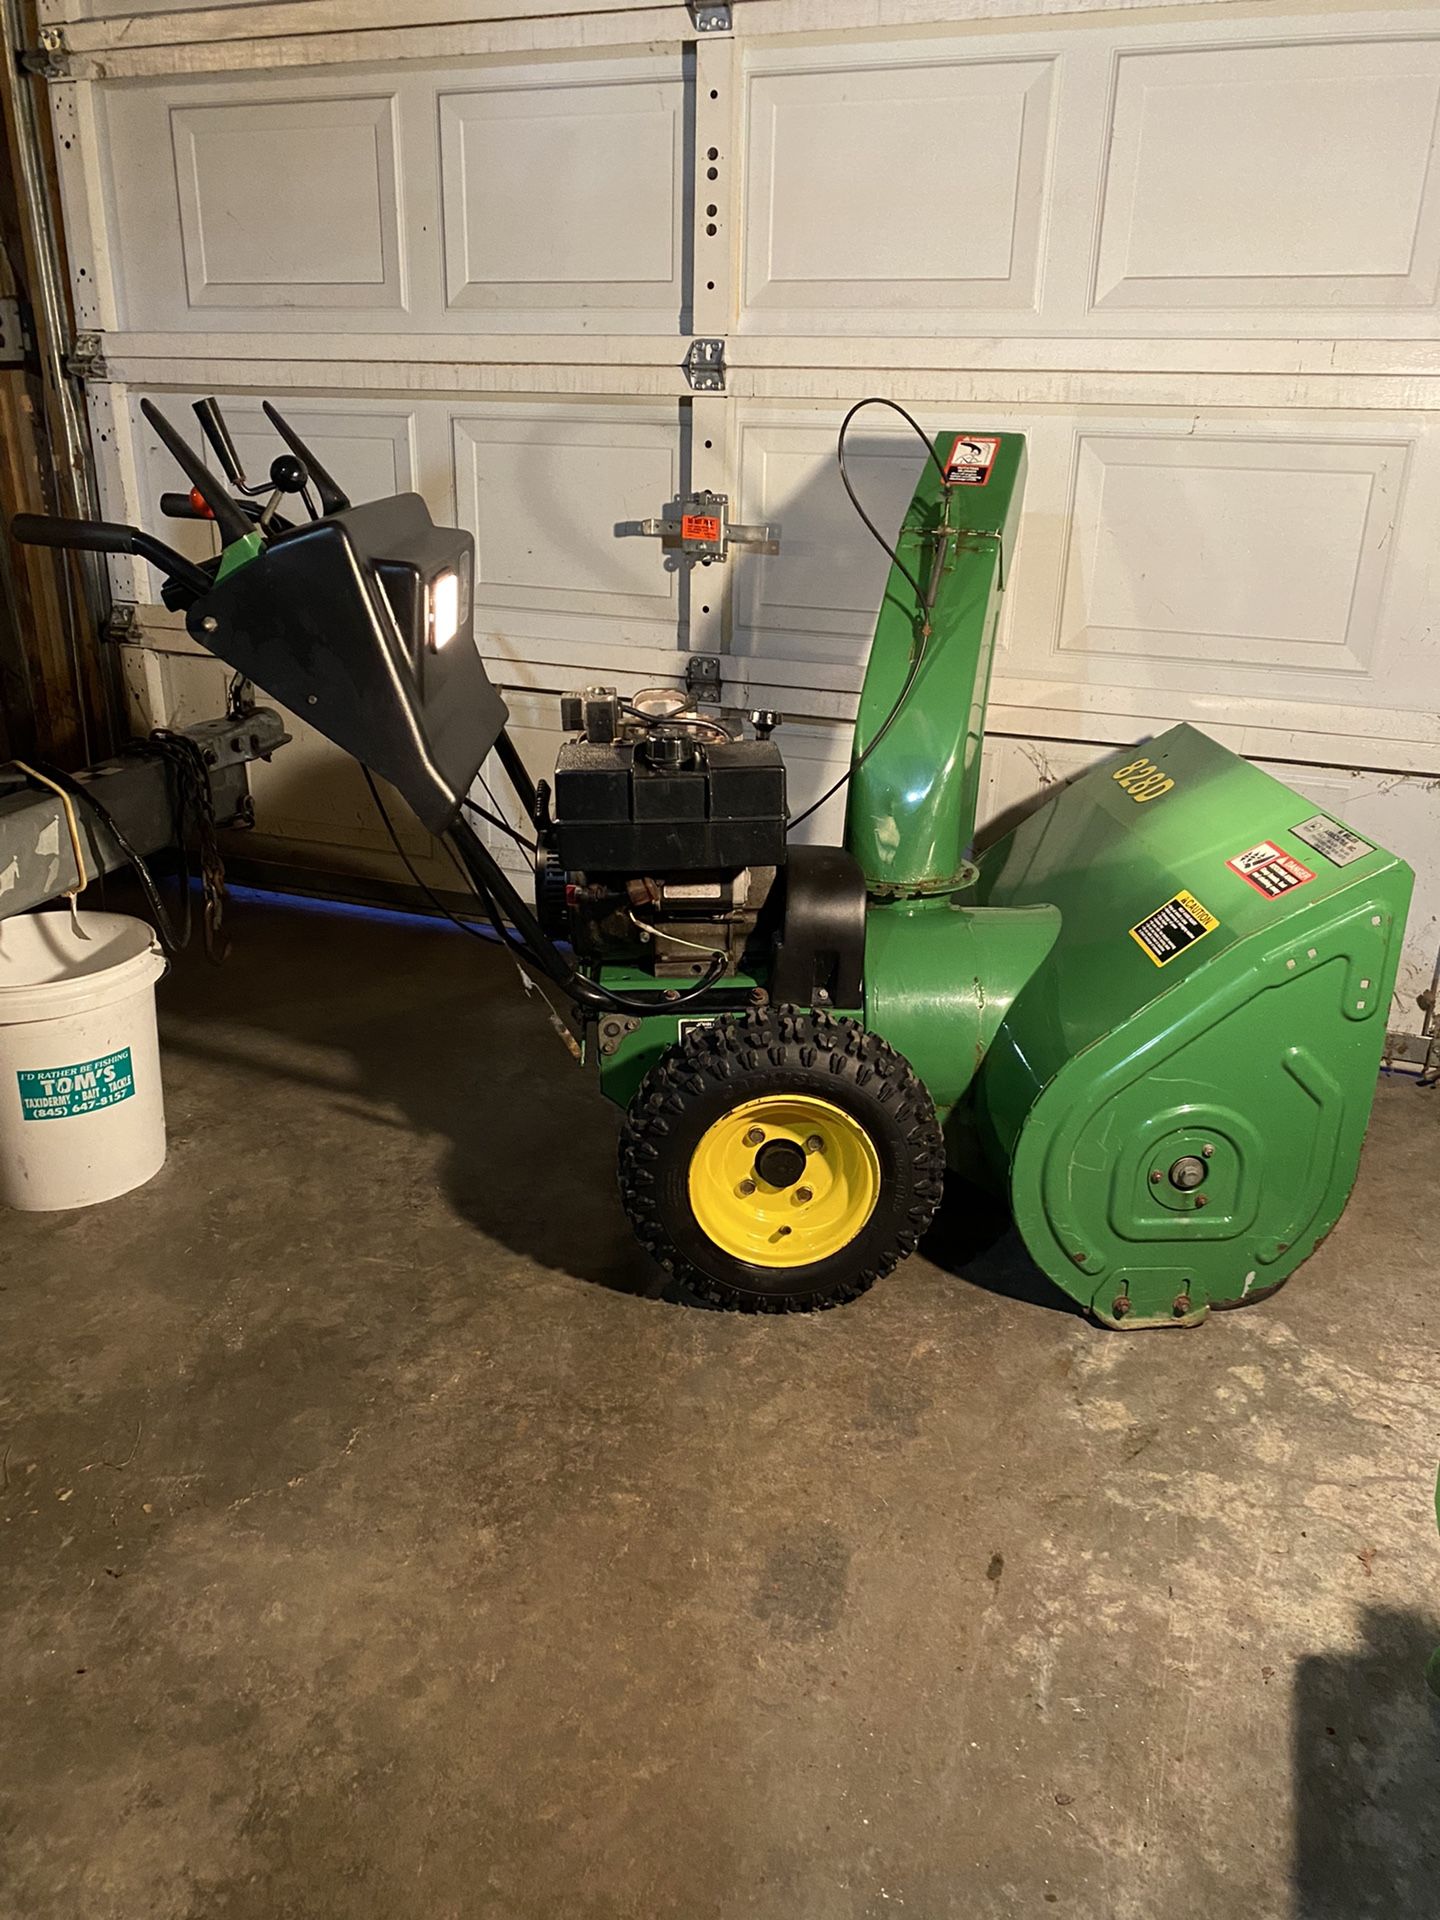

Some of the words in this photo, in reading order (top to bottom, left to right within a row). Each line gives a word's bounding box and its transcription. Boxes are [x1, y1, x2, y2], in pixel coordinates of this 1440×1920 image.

[1113, 758, 1175, 802] 828D
[1185, 899, 1214, 925] CAUTION
[37, 1068, 77, 1080] RATHER
[80, 1064, 93, 1072] BE
[94, 1051, 129, 1069] FISHING
[40, 1064, 116, 1096] TOM'S
[24, 1094, 71, 1109] TAXIDERMY
[82, 1087, 100, 1102] BAIT
[108, 1074, 132, 1093] TACKLE
[33, 1106, 68, 1119] (845)
[72, 1088, 127, 1113] 647-8157
